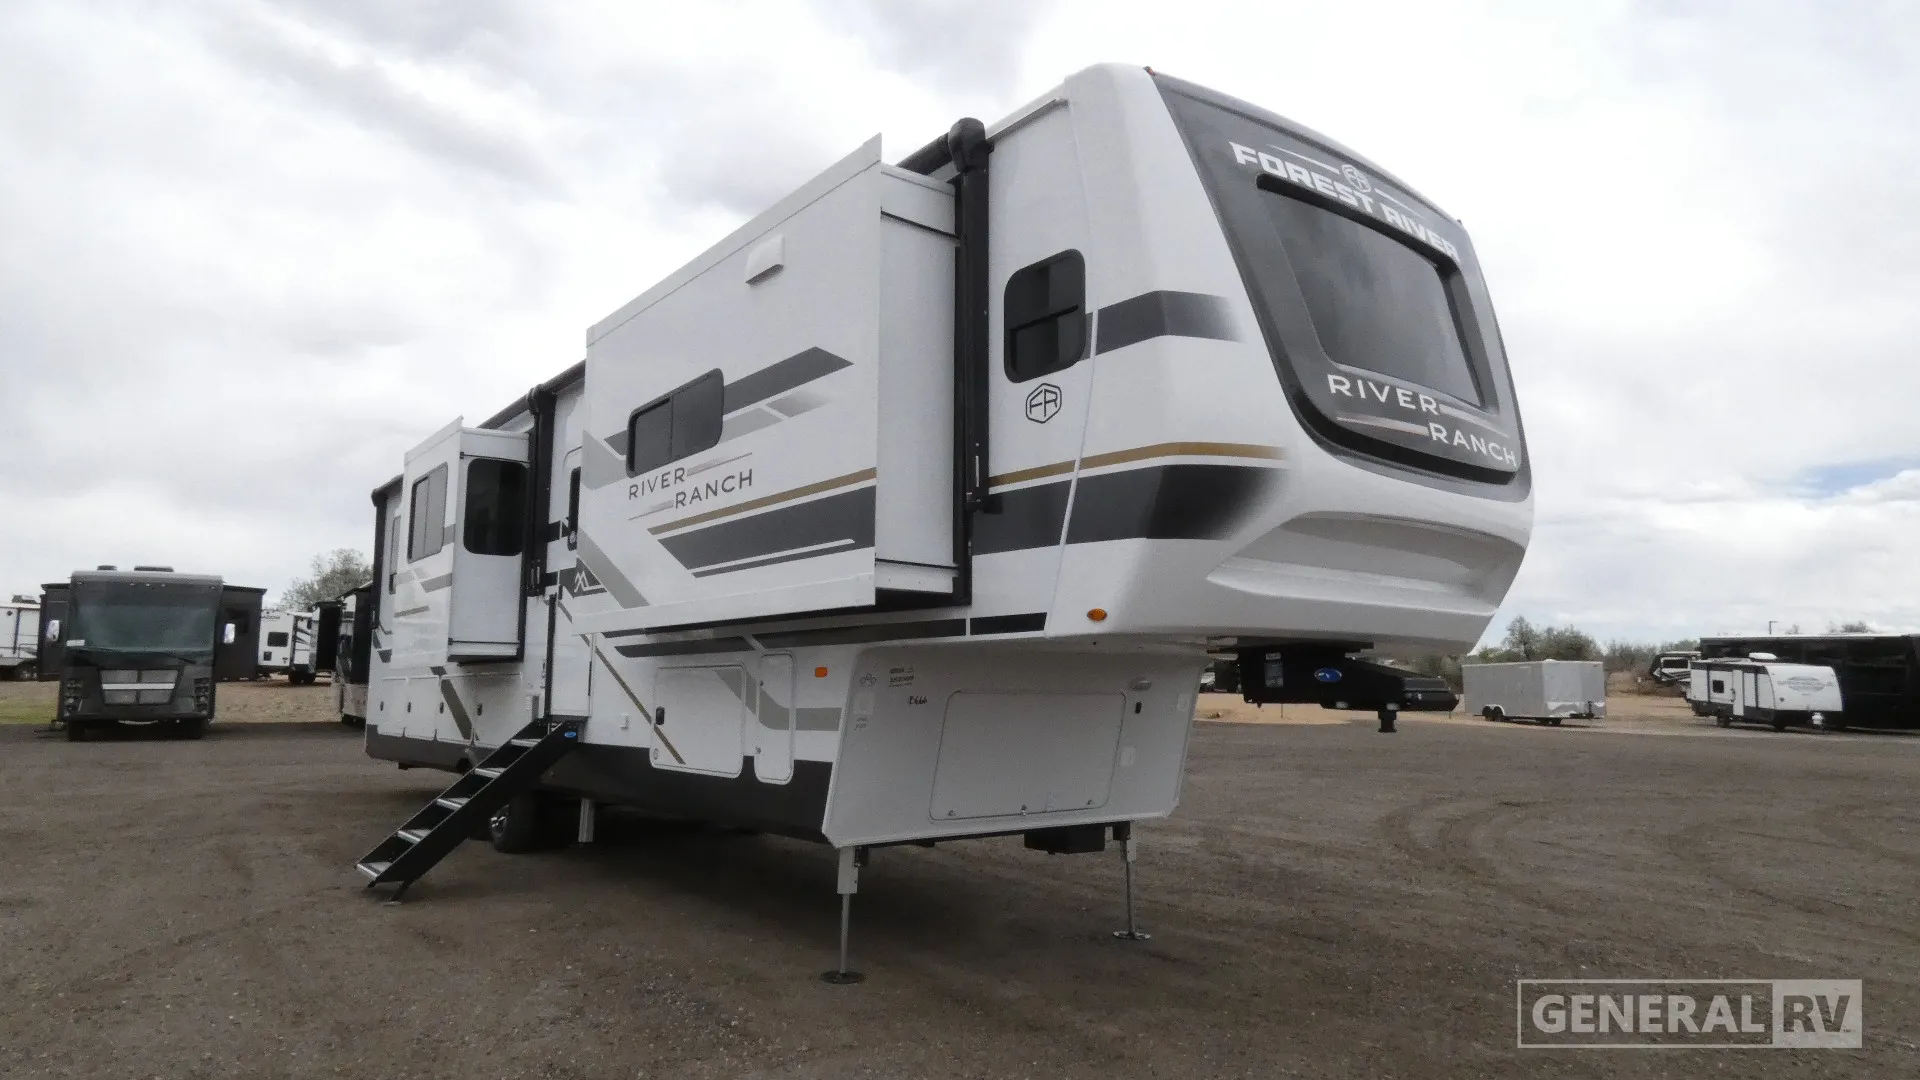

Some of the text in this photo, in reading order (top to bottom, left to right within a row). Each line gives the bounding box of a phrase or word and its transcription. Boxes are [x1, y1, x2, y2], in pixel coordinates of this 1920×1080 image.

[1228, 141, 1461, 265] FOREST RIVER
[1028, 387, 1059, 418] FR
[1327, 374, 1441, 415] RIVER
[1429, 421, 1517, 468] RANCH
[628, 467, 686, 501] RIVER
[675, 468, 753, 509] RANCH
